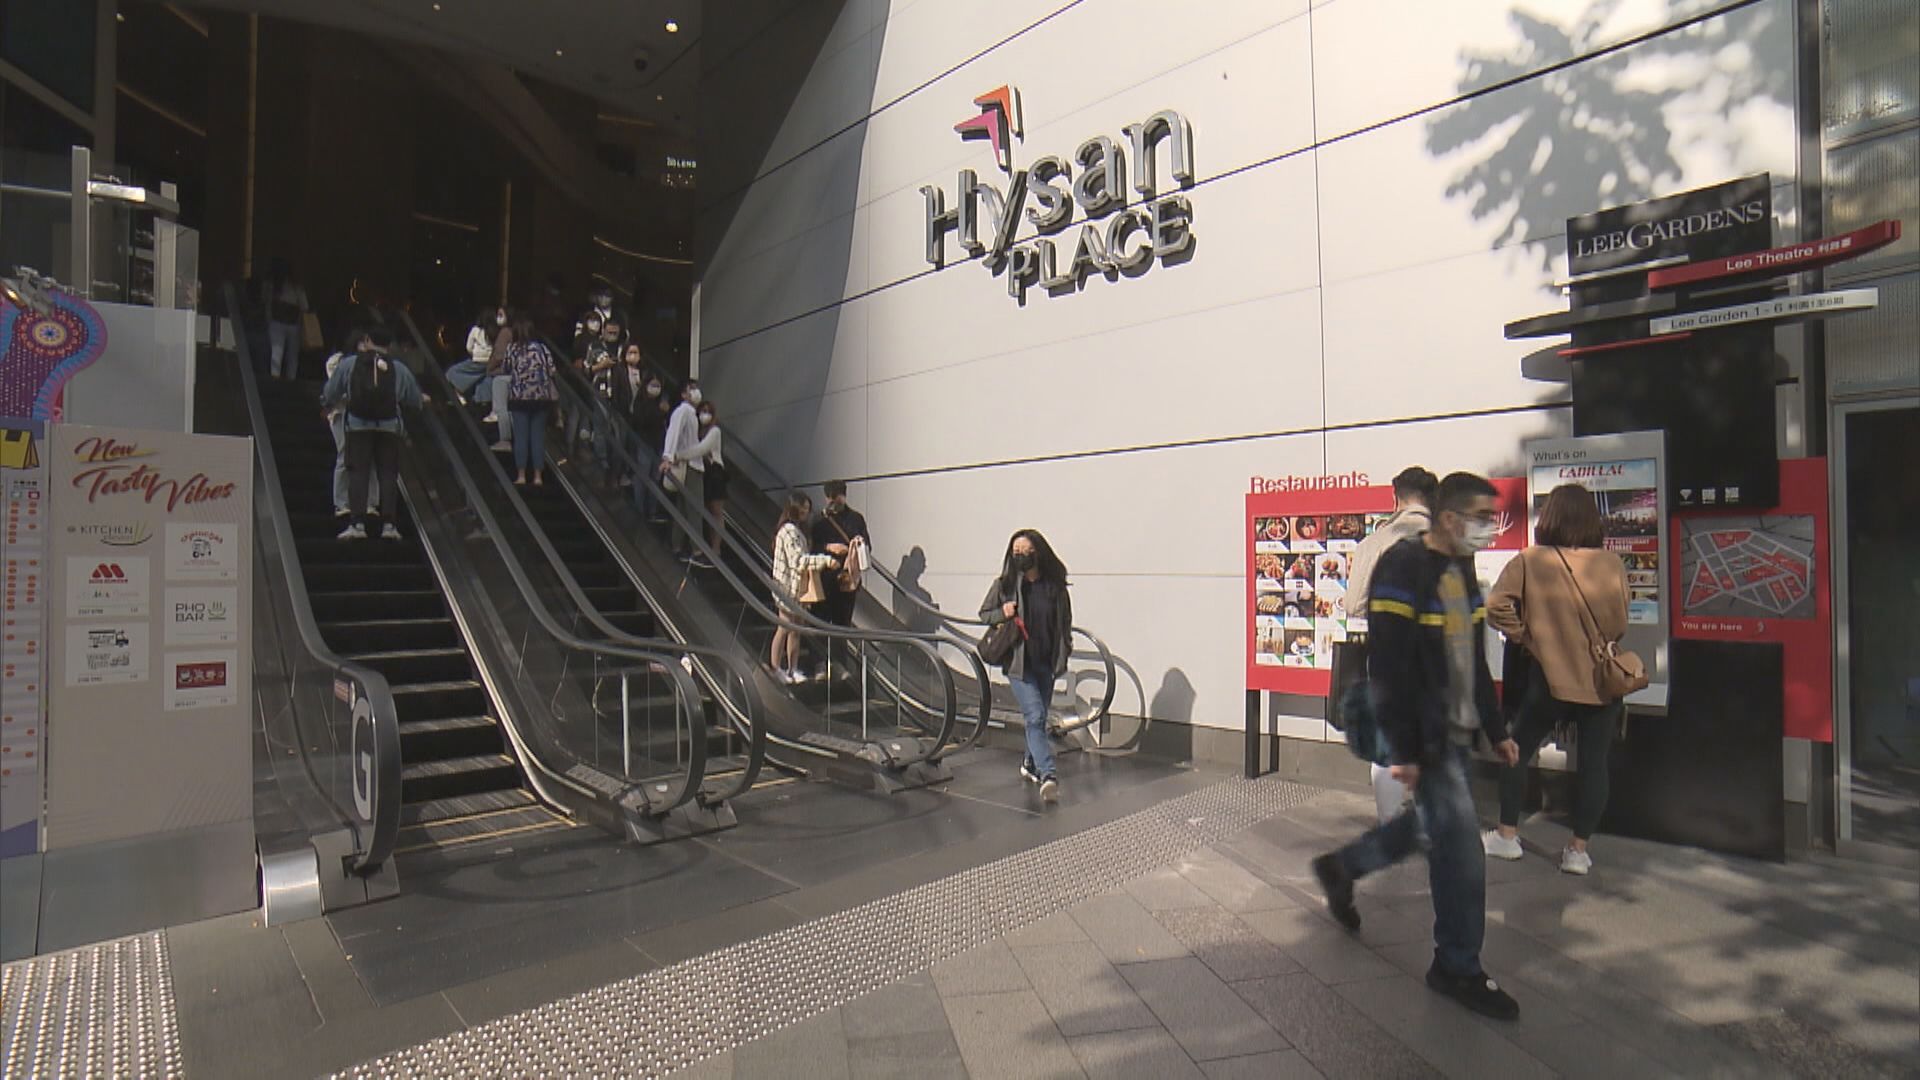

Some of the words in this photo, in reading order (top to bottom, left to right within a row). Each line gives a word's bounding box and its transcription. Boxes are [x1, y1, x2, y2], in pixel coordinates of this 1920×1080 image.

[919, 109, 1194, 273] Hysan
[1007, 195, 1195, 303] PLACE
[1726, 258, 1752, 271] Lee
[1756, 247, 1814, 265] Theatre
[1671, 319, 1695, 330] Lee
[1698, 310, 1748, 325] Garden
[1754, 306, 1760, 316] 1
[1774, 303, 1783, 313] 6
[74, 437, 138, 463] New
[1533, 450, 1569, 461] What's
[1572, 450, 1587, 458] on
[1250, 471, 1369, 494] Restaurants
[1559, 464, 1625, 478] CADILLAC
[72, 464, 160, 504] Tasty
[155, 473, 236, 513] Vibes
[80, 525, 133, 536] KITCHEN
[175, 602, 206, 613] PHO
[175, 613, 206, 622] BAR
[1681, 621, 1699, 630] You
[1720, 622, 1743, 631] here
[352, 697, 372, 820] G
